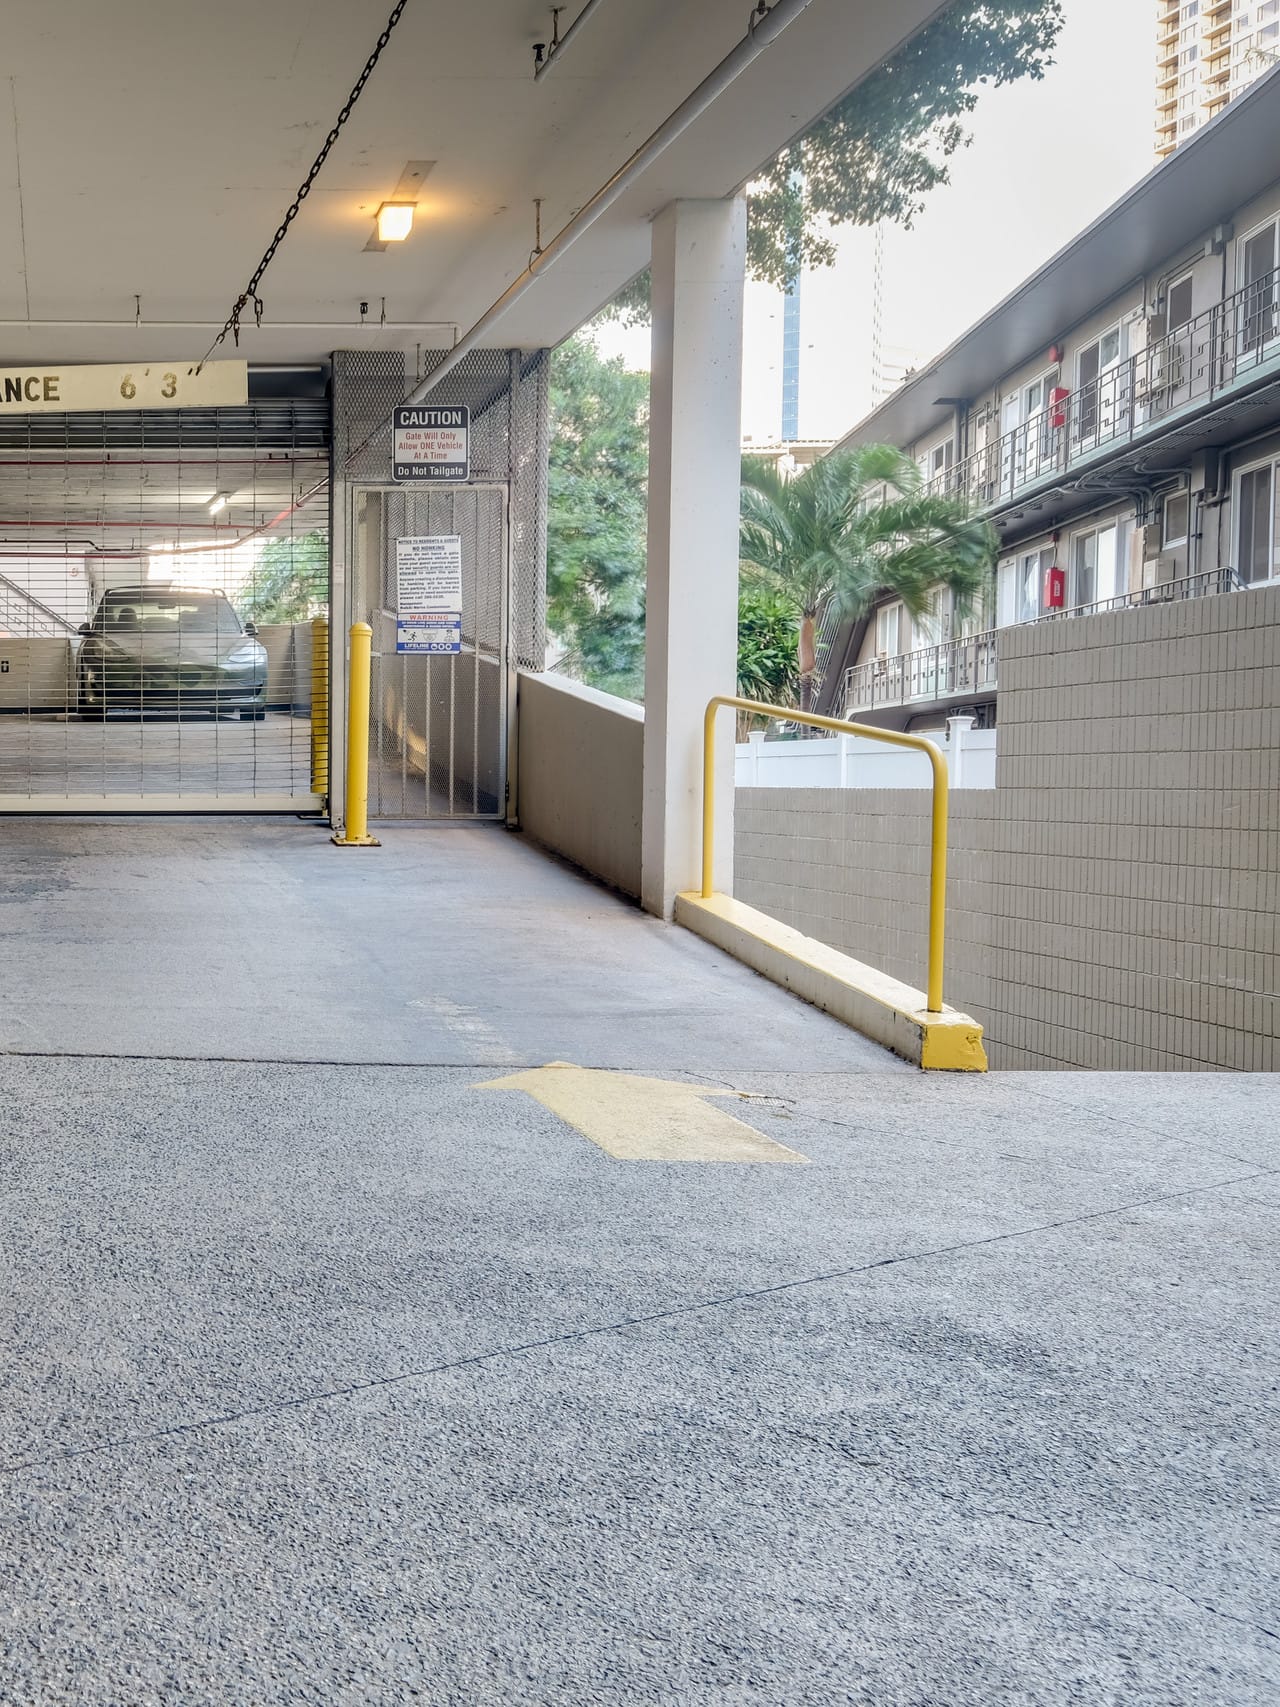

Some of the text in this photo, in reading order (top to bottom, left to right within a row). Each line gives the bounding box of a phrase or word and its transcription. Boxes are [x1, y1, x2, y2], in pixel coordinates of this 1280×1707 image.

[400, 411, 461, 425] CAUTION
[405, 432, 456, 441] Gate Will Only
[399, 442, 418, 450] Allow
[398, 466, 463, 477] Do Not Tailgate
